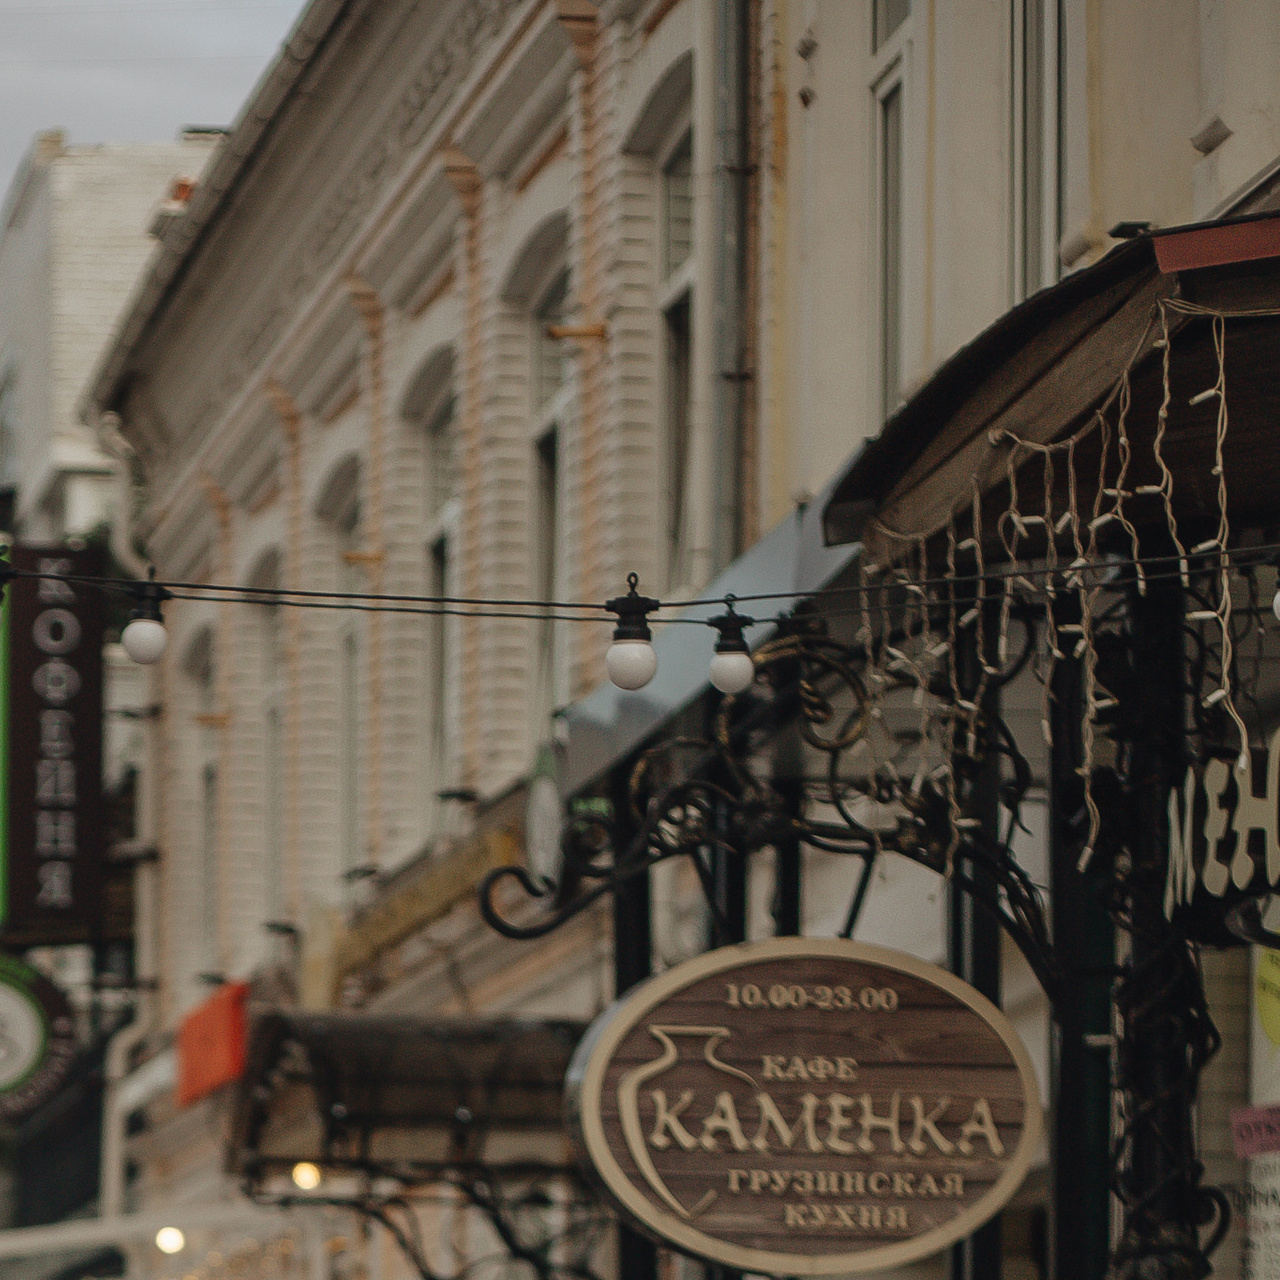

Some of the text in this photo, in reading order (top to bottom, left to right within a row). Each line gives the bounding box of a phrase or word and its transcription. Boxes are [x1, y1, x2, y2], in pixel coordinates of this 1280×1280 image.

[761, 1054, 859, 1082] КАФЕ
[647, 1089, 1005, 1157] КАМЕНКА
[727, 1169, 966, 1198] ГРУЗИНСКАЯ
[784, 1205, 910, 1231] КУХНЯ
